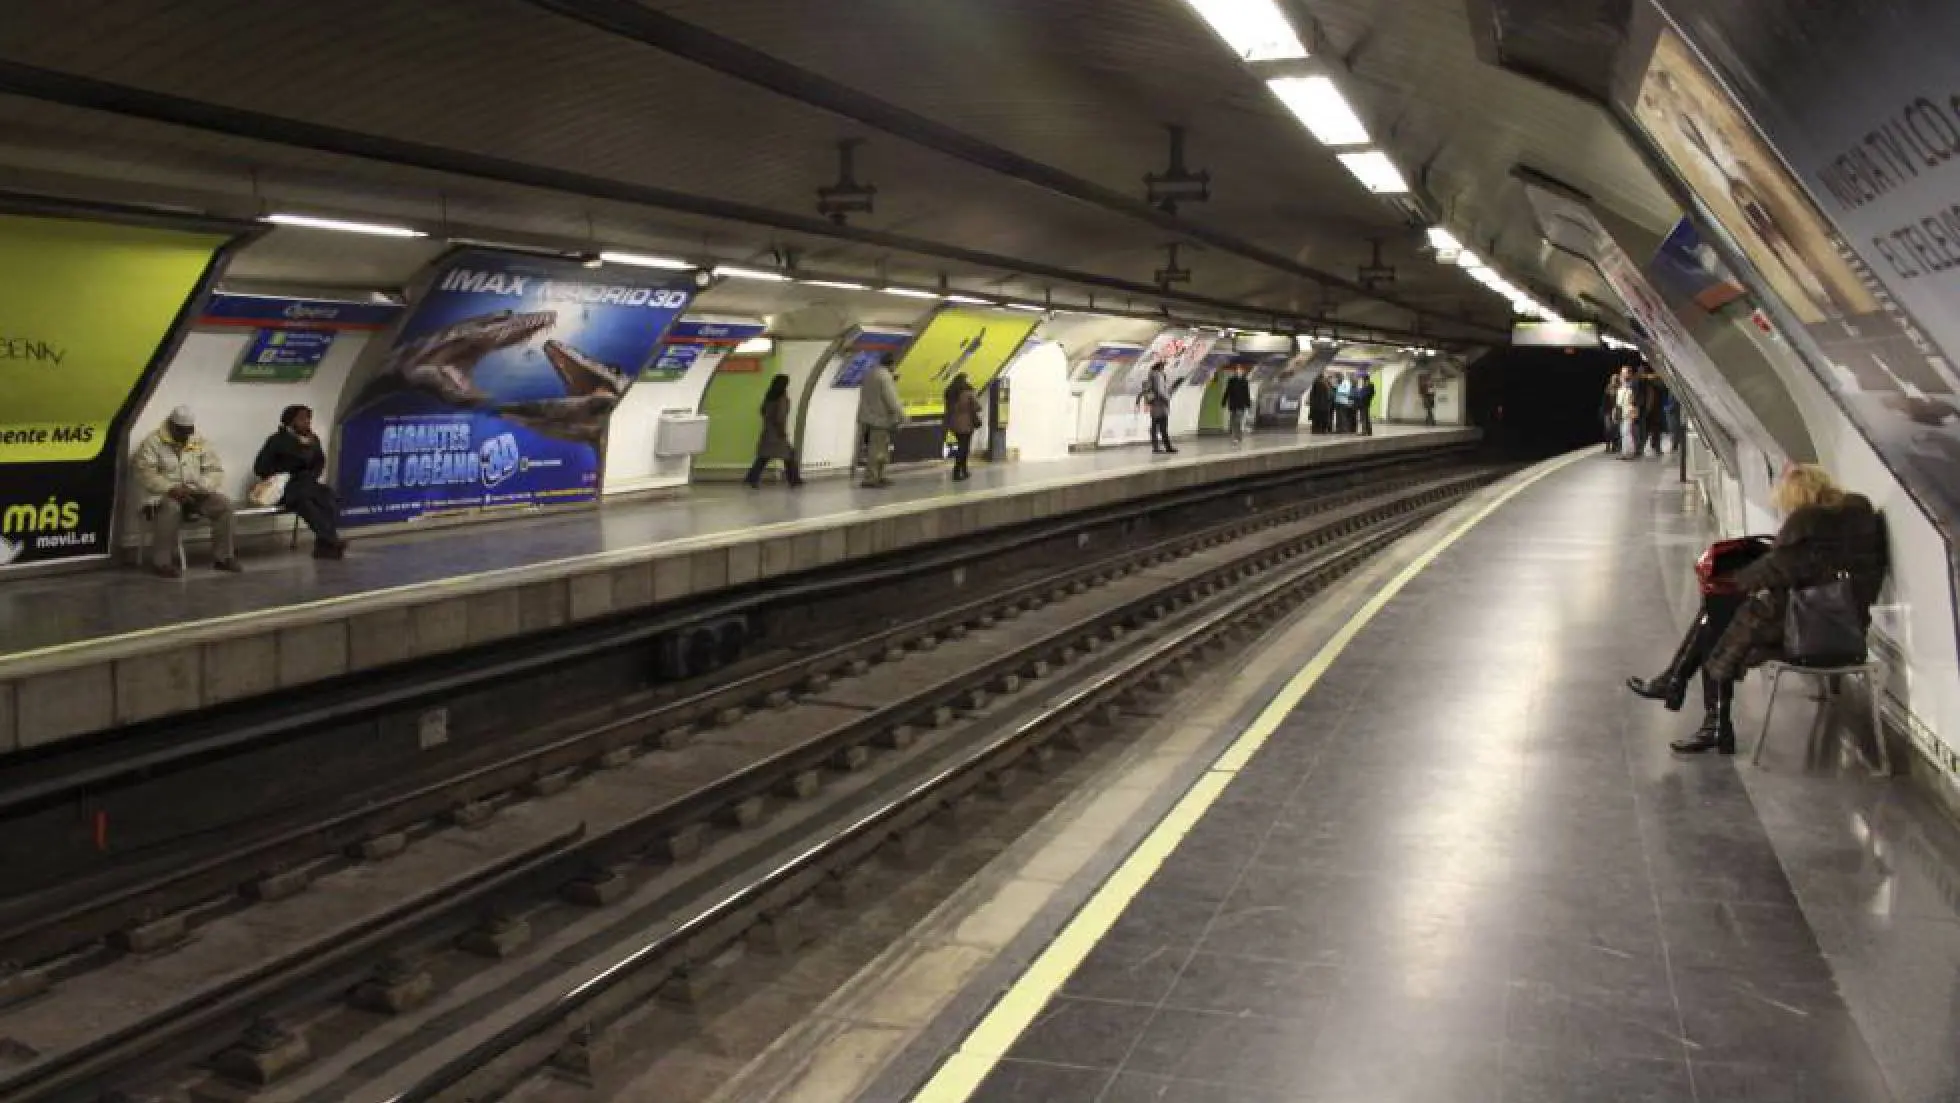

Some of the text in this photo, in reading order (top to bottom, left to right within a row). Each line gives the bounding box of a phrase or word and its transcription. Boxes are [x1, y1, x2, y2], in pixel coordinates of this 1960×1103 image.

[441, 267, 529, 296] IMAX
[648, 288, 689, 309] 3D
[0, 428, 48, 445] ente
[382, 422, 472, 453] GIGANTES
[361, 454, 400, 490] DEL
[402, 447, 481, 487] OCÉANO
